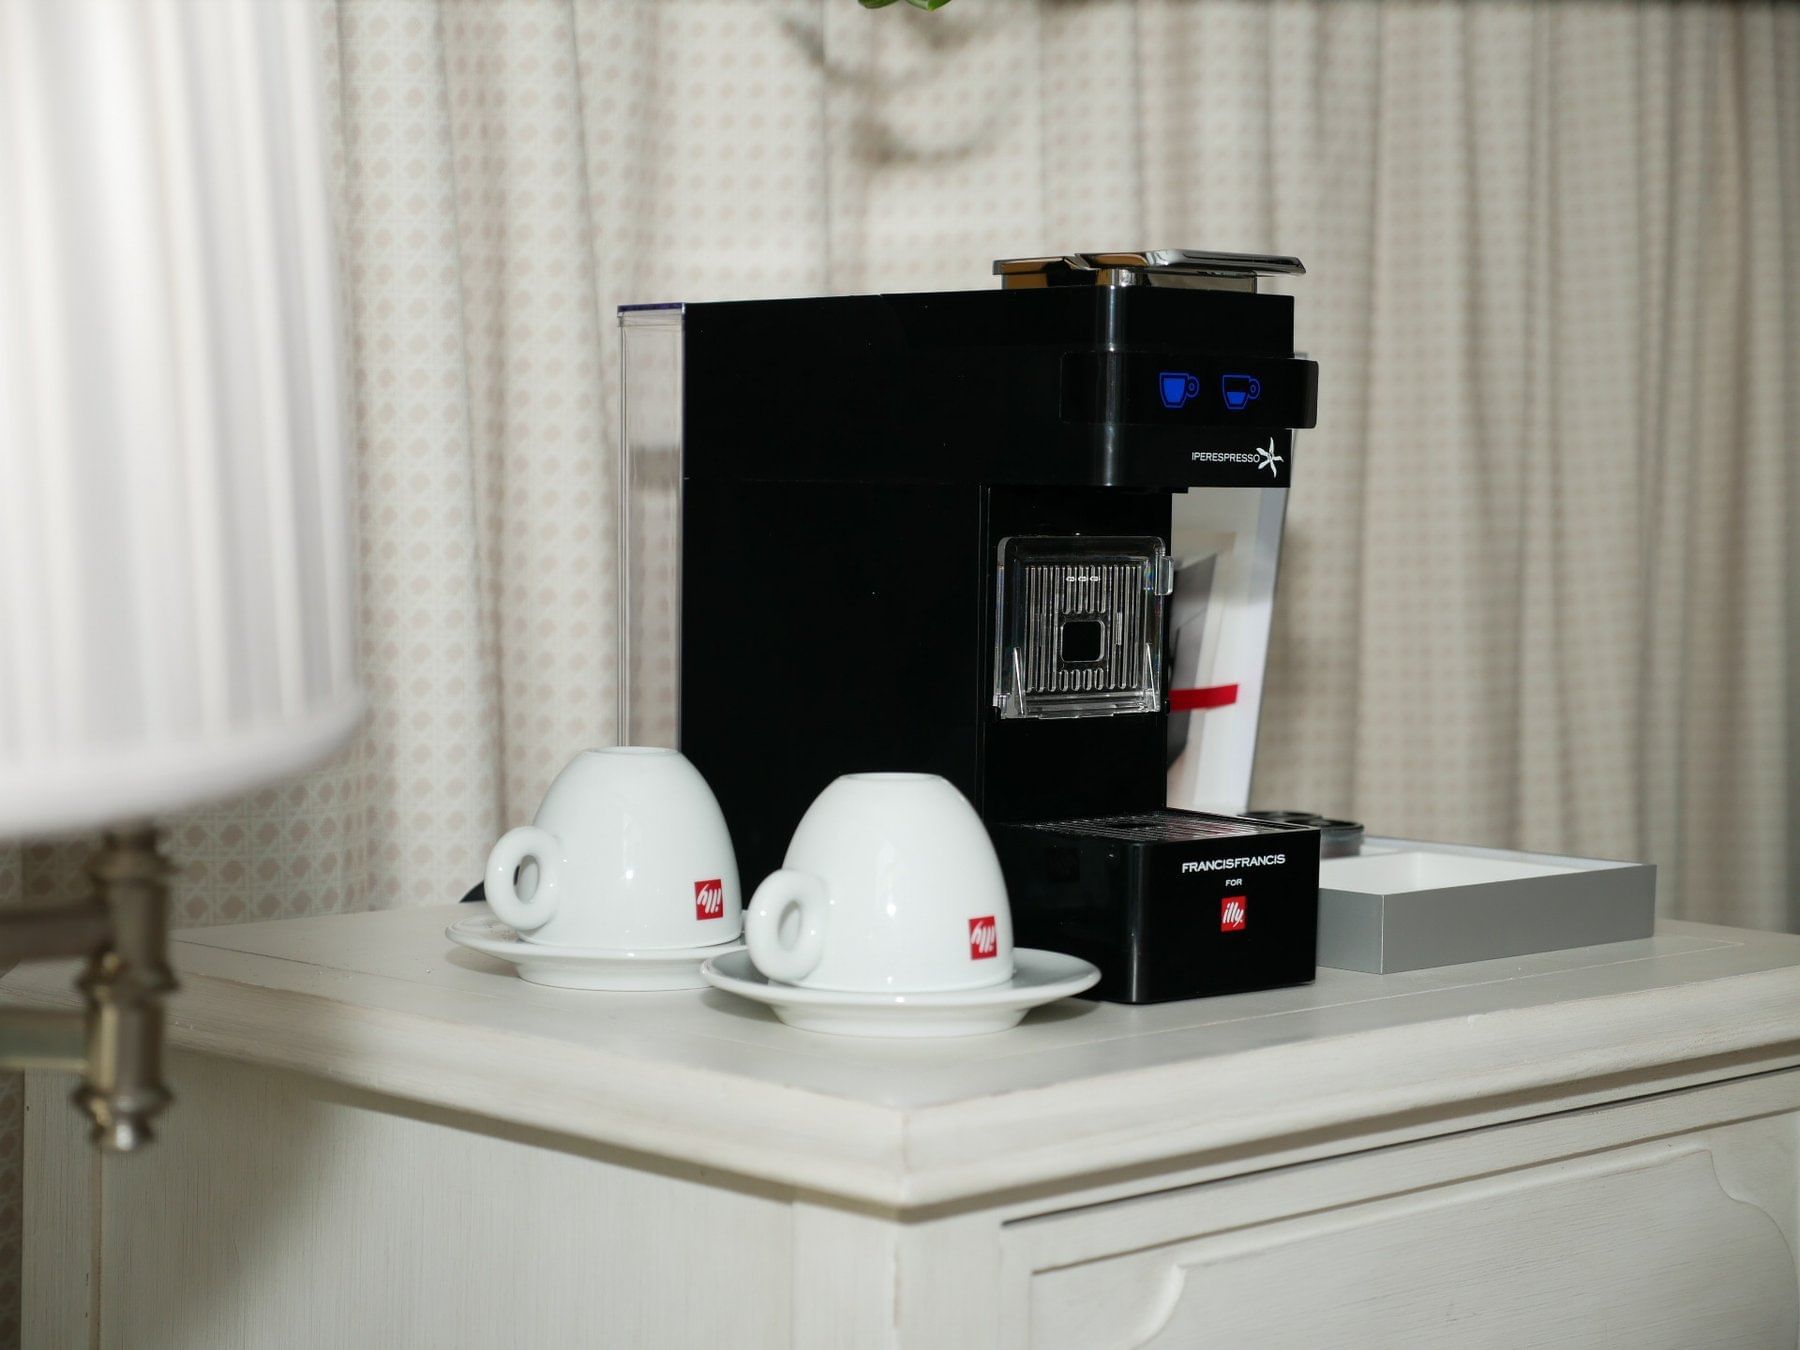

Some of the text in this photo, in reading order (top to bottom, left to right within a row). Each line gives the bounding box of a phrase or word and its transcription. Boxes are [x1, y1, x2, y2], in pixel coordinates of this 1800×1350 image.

[1191, 451, 1261, 463] IPERESPRESSO
[1182, 854, 1286, 873] FRANCISFRANCIS
[1225, 878, 1243, 887] FOR
